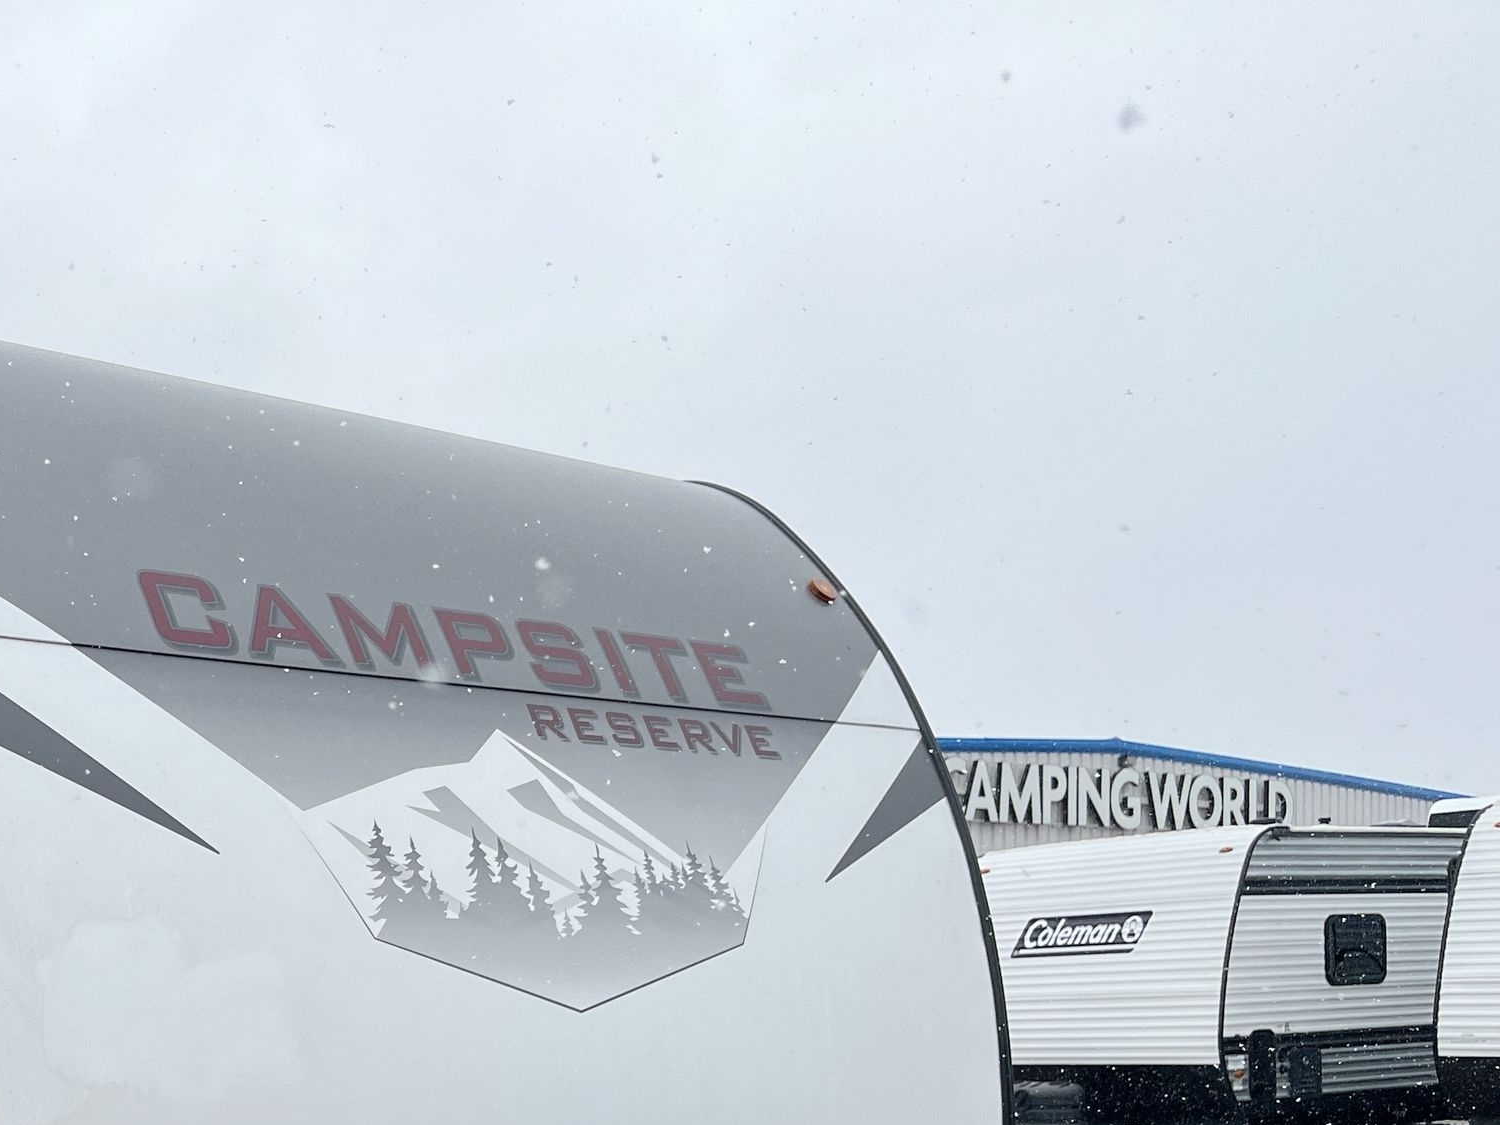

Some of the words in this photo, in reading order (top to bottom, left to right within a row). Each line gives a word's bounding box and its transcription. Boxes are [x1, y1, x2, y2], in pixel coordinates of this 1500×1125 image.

[136, 568, 773, 712] CAMPSITE
[525, 703, 782, 760] RESERVE
[1147, 771, 1294, 831] WORLD
[1023, 917, 1122, 949] Coleman
